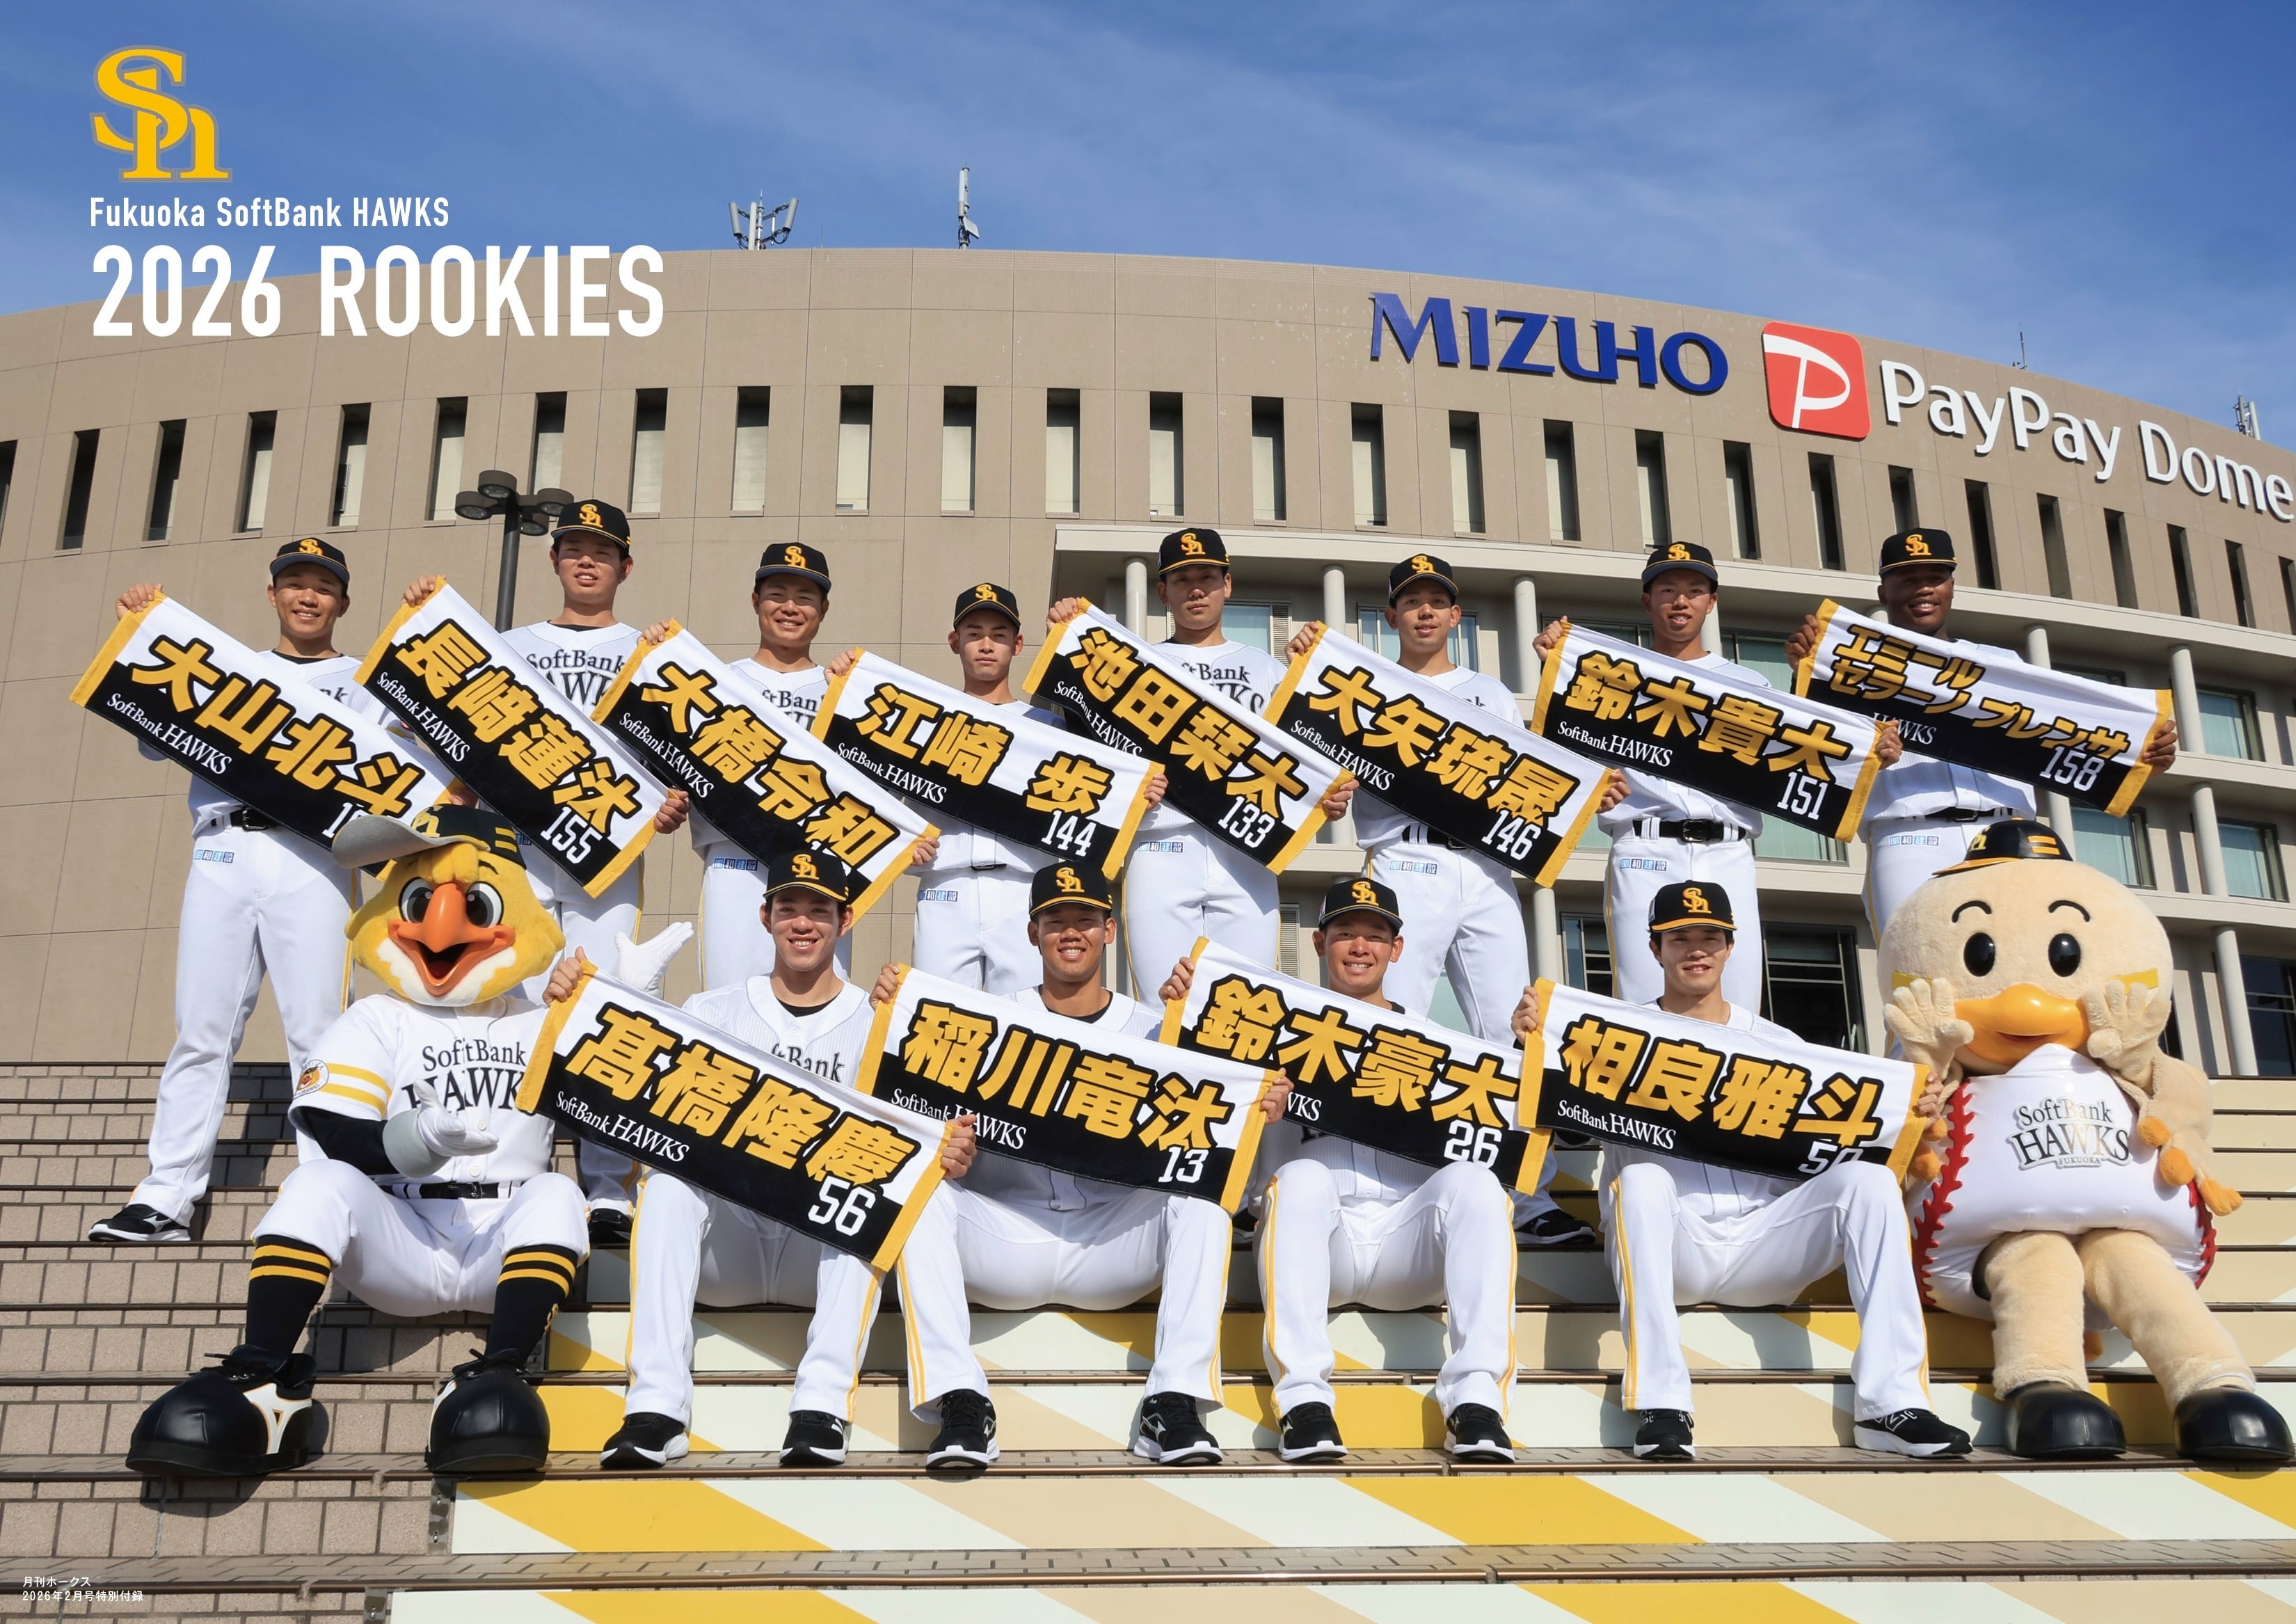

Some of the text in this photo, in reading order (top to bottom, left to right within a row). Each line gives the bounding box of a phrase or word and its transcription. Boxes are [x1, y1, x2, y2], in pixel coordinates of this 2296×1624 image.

[1370, 292, 1729, 396] MIZUHO
[1881, 359, 2295, 520] PayPay Dome
[1833, 625, 1984, 689] エミール
[129, 637, 422, 817] 大山北斗
[377, 672, 470, 762] SoftBank HAWKS
[1054, 680, 1092, 722] SoftBank
[1070, 628, 1307, 818] 池田栞太
[1563, 651, 1849, 783] 鈴木貴大
[1831, 656, 2131, 758] セラーノ プレンサ
[107, 693, 232, 774] SoftBank HAWKS
[619, 712, 715, 799] SoftBank HAWKS
[1291, 720, 1395, 792] SoftBank HAWKS
[1308, 667, 1579, 827] 大矢琉晟
[1557, 721, 1673, 767] SoftBank HAWKS
[639, 663, 898, 867] 大橋令和
[836, 742, 946, 804] SoftBank HAWKS
[1024, 752, 1113, 815] 歩
[1778, 771, 1829, 820] 151
[2040, 746, 2105, 792] 158
[541, 805, 603, 864] 155
[1041, 809, 1097, 857] 144
[1218, 795, 1275, 848] 133
[1482, 809, 1542, 861] 146
[422, 1037, 526, 1072] SoftBank
[902, 1000, 1232, 1150] 稲川竜汰
[1195, 976, 1518, 1127] 鈴木豪太
[1561, 1015, 1881, 1147] 相良雅斗
[556, 1090, 690, 1163] SoftBank HAWKS
[891, 1088, 952, 1122] SoftBank
[1287, 1091, 1322, 1122] WKS
[1558, 1100, 1676, 1149] SoftBank HAWKS
[2019, 1099, 2113, 1127] SoftBank
[1158, 1146, 1210, 1184] 13
[1444, 1119, 1503, 1169] 26
[2012, 1124, 2130, 1165] HAWKS
[2059, 1156, 2100, 1165] FUKUOKA
[808, 1175, 877, 1236] 56
